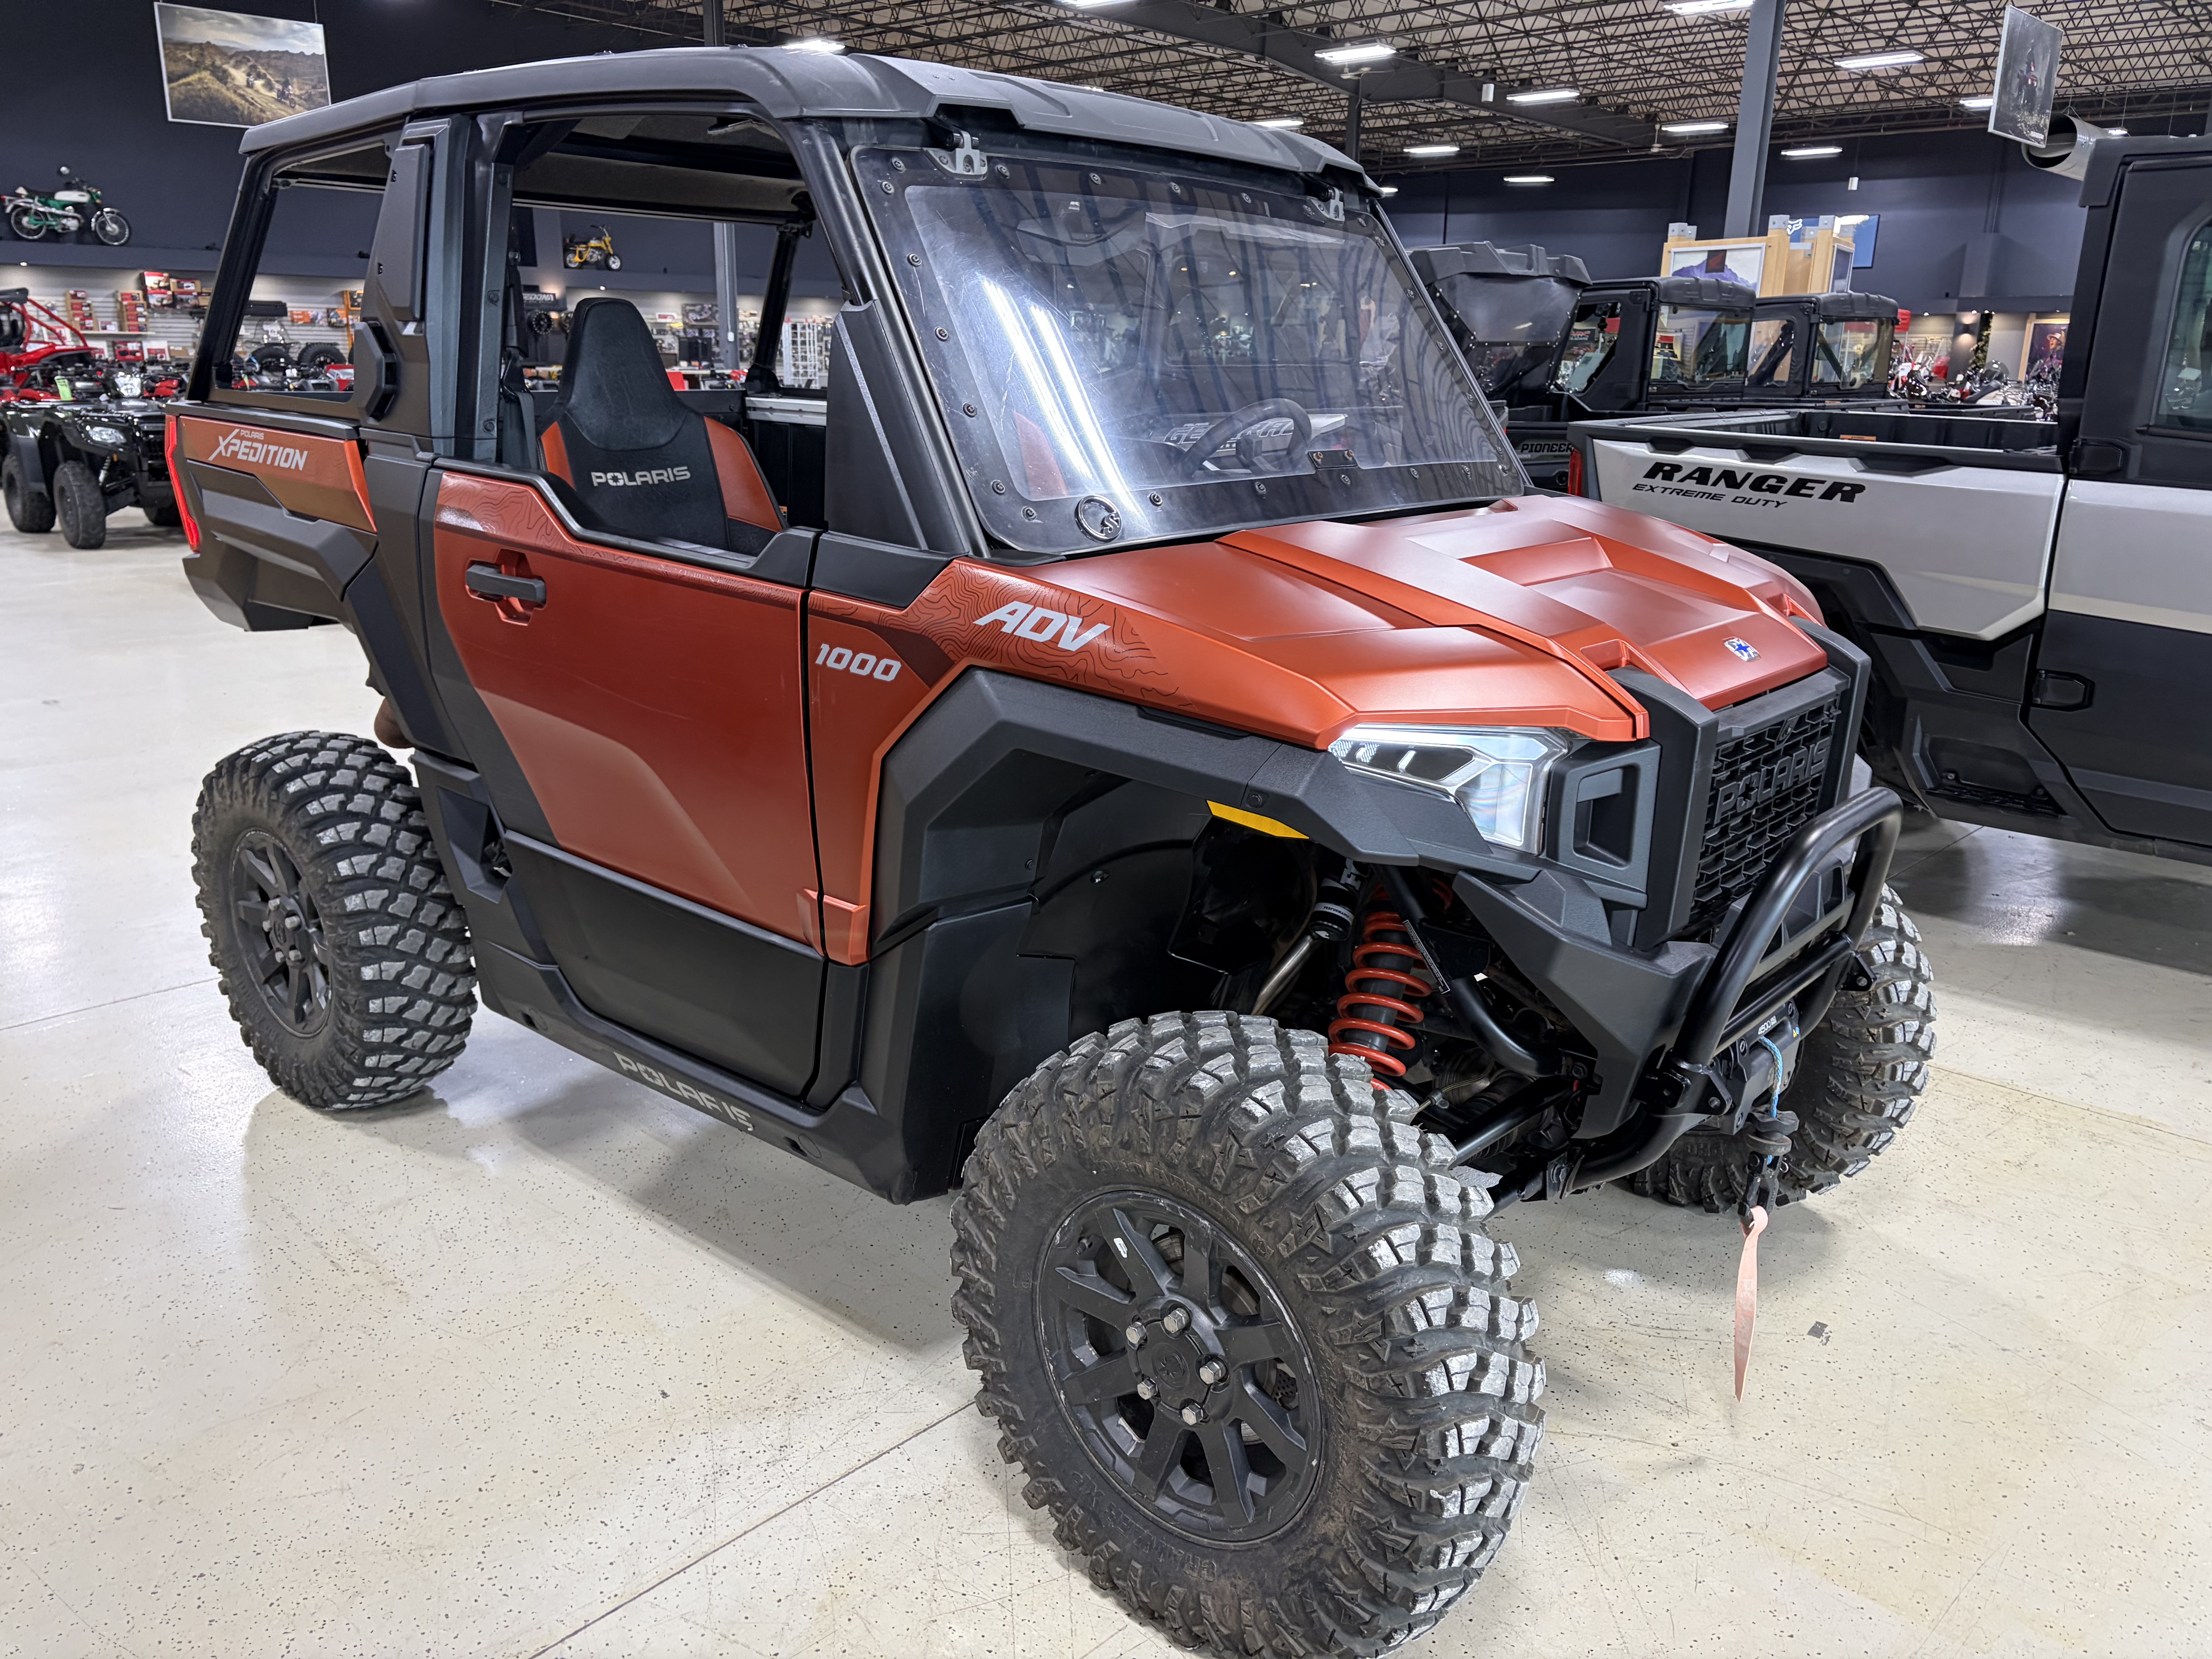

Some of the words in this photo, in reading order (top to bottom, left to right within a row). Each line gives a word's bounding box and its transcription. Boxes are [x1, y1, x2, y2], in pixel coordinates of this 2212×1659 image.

[523, 294, 554, 302] EDONA
[208, 429, 308, 471] XPEDITION
[240, 429, 264, 439] POLARIS
[1520, 443, 1572, 453] PIONEER
[591, 466, 690, 487] POLARIS
[1632, 483, 1725, 501] EXTREME
[1731, 496, 1788, 508] DUTY
[1643, 462, 1867, 503] RANGER
[973, 601, 1110, 651] ADV
[815, 643, 901, 682] 1000
[1713, 737, 1832, 825] POLARIS
[614, 1051, 754, 1132] POLARIS
